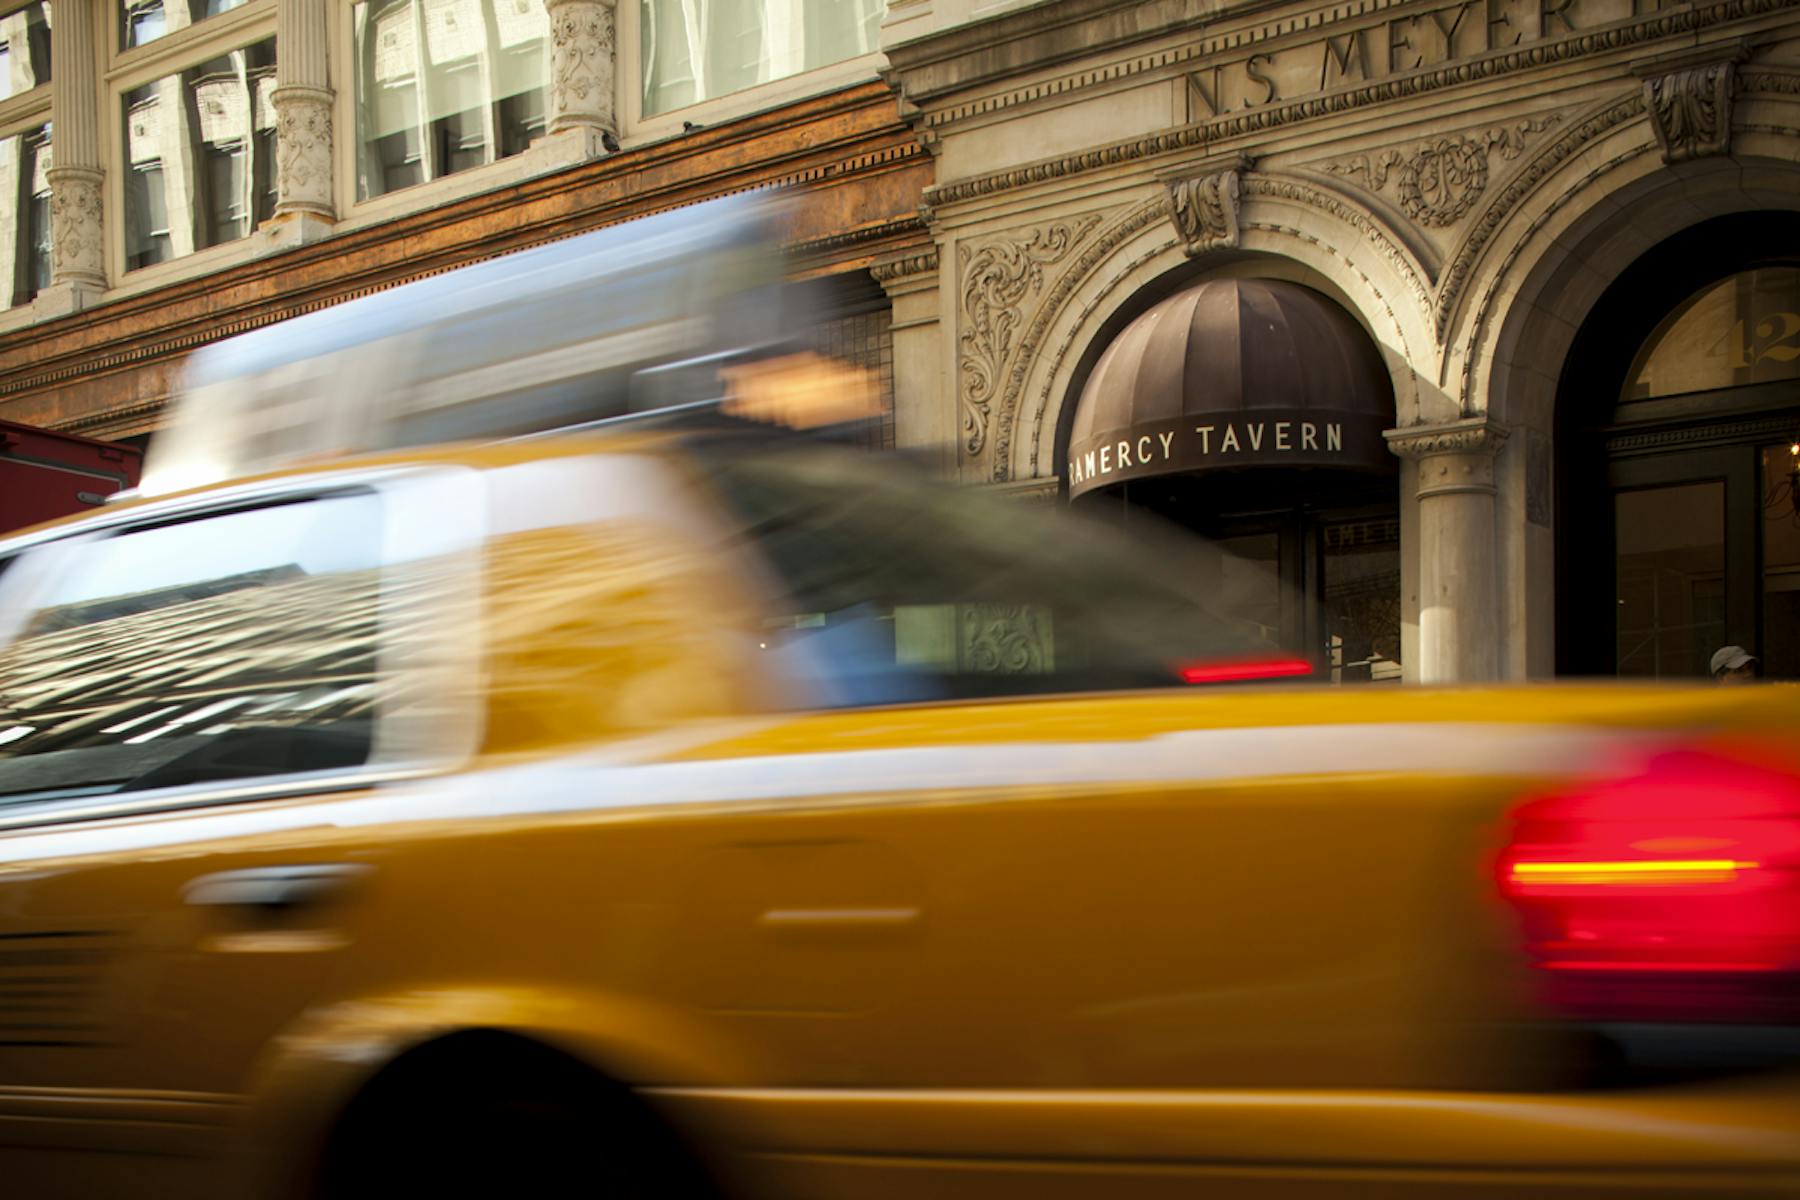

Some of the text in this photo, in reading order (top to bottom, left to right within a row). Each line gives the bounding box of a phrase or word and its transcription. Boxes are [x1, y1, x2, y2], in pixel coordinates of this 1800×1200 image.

[1319, 0, 1577, 92] MEYER
[1068, 422, 1342, 486] RAMERCY TAVERN
